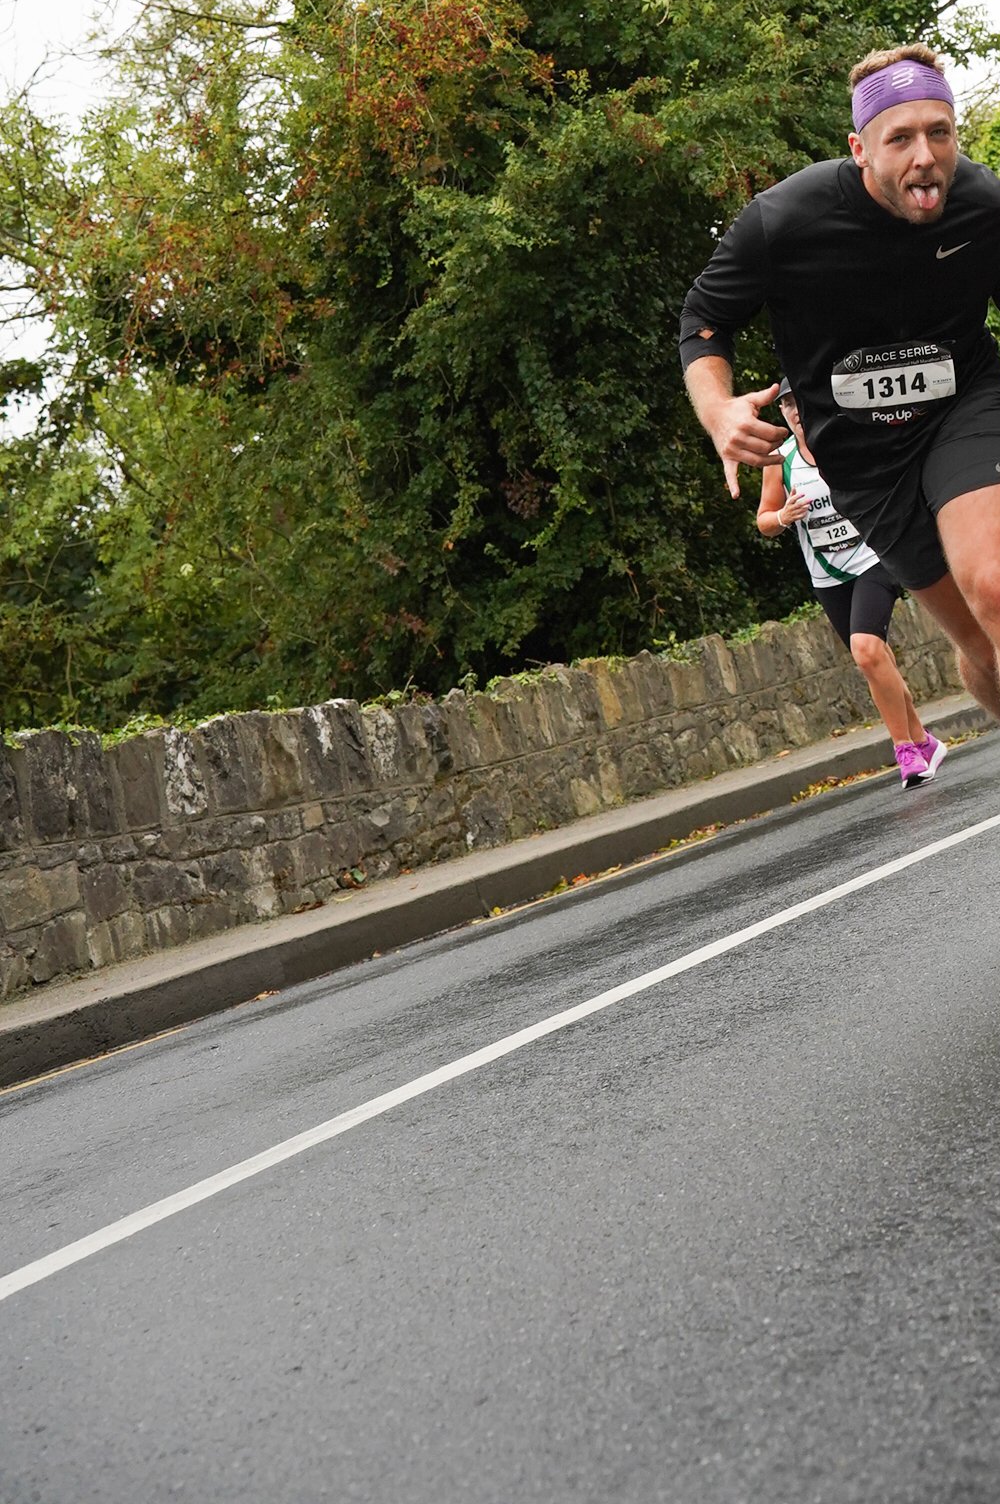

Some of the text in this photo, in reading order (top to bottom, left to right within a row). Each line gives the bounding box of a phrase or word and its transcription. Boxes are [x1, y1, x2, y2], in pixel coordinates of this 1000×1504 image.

[865, 344, 939, 364] RACE SERIES
[862, 372, 927, 400] 1314
[872, 412, 893, 423] Pop
[895, 409, 913, 420] Up
[821, 516, 835, 524] RACE
[826, 525, 848, 539] 128
